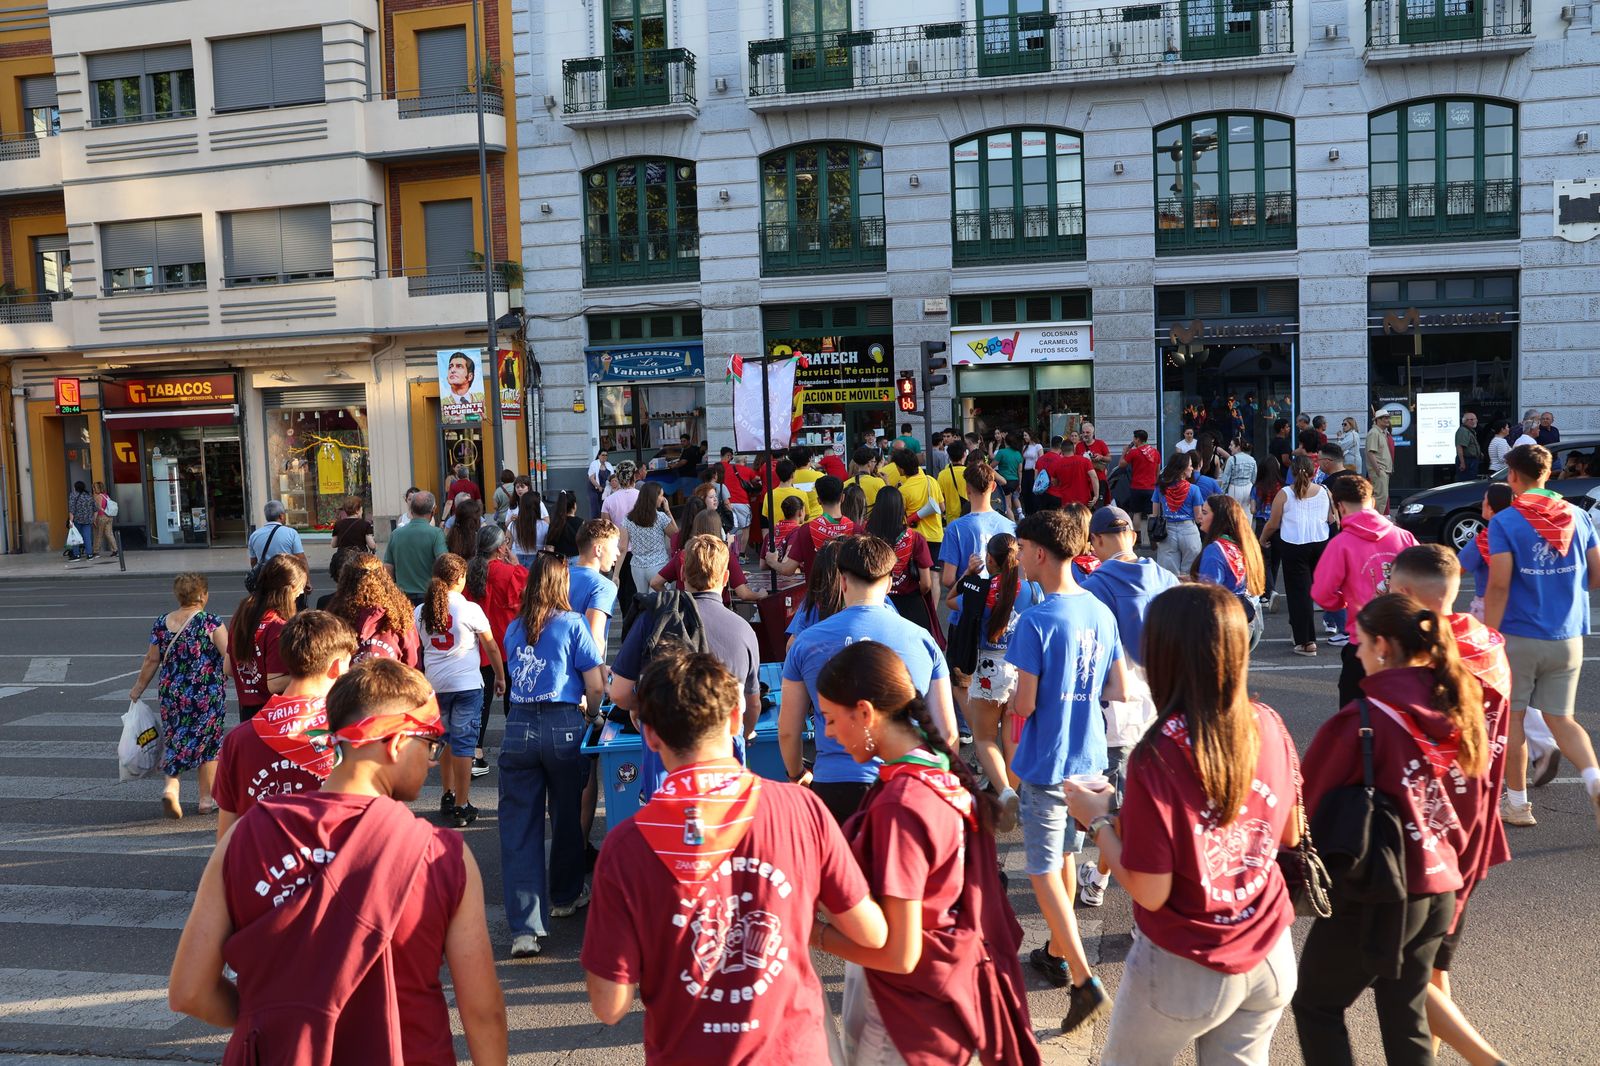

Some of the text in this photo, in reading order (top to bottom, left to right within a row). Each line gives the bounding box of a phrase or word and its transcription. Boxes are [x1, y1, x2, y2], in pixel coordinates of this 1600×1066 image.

[637, 358, 659, 367] La
[612, 365, 683, 376] Valenciana
[795, 366, 889, 377] Servicio Técnico
[147, 381, 212, 397] TABACOS
[836, 391, 847, 401] DE
[443, 403, 483, 412] MORANTE
[451, 407, 483, 416] PUEBLA
[268, 703, 301, 722] FERIAS
[279, 714, 328, 734] SAN PED
[680, 775, 693, 792] Y
